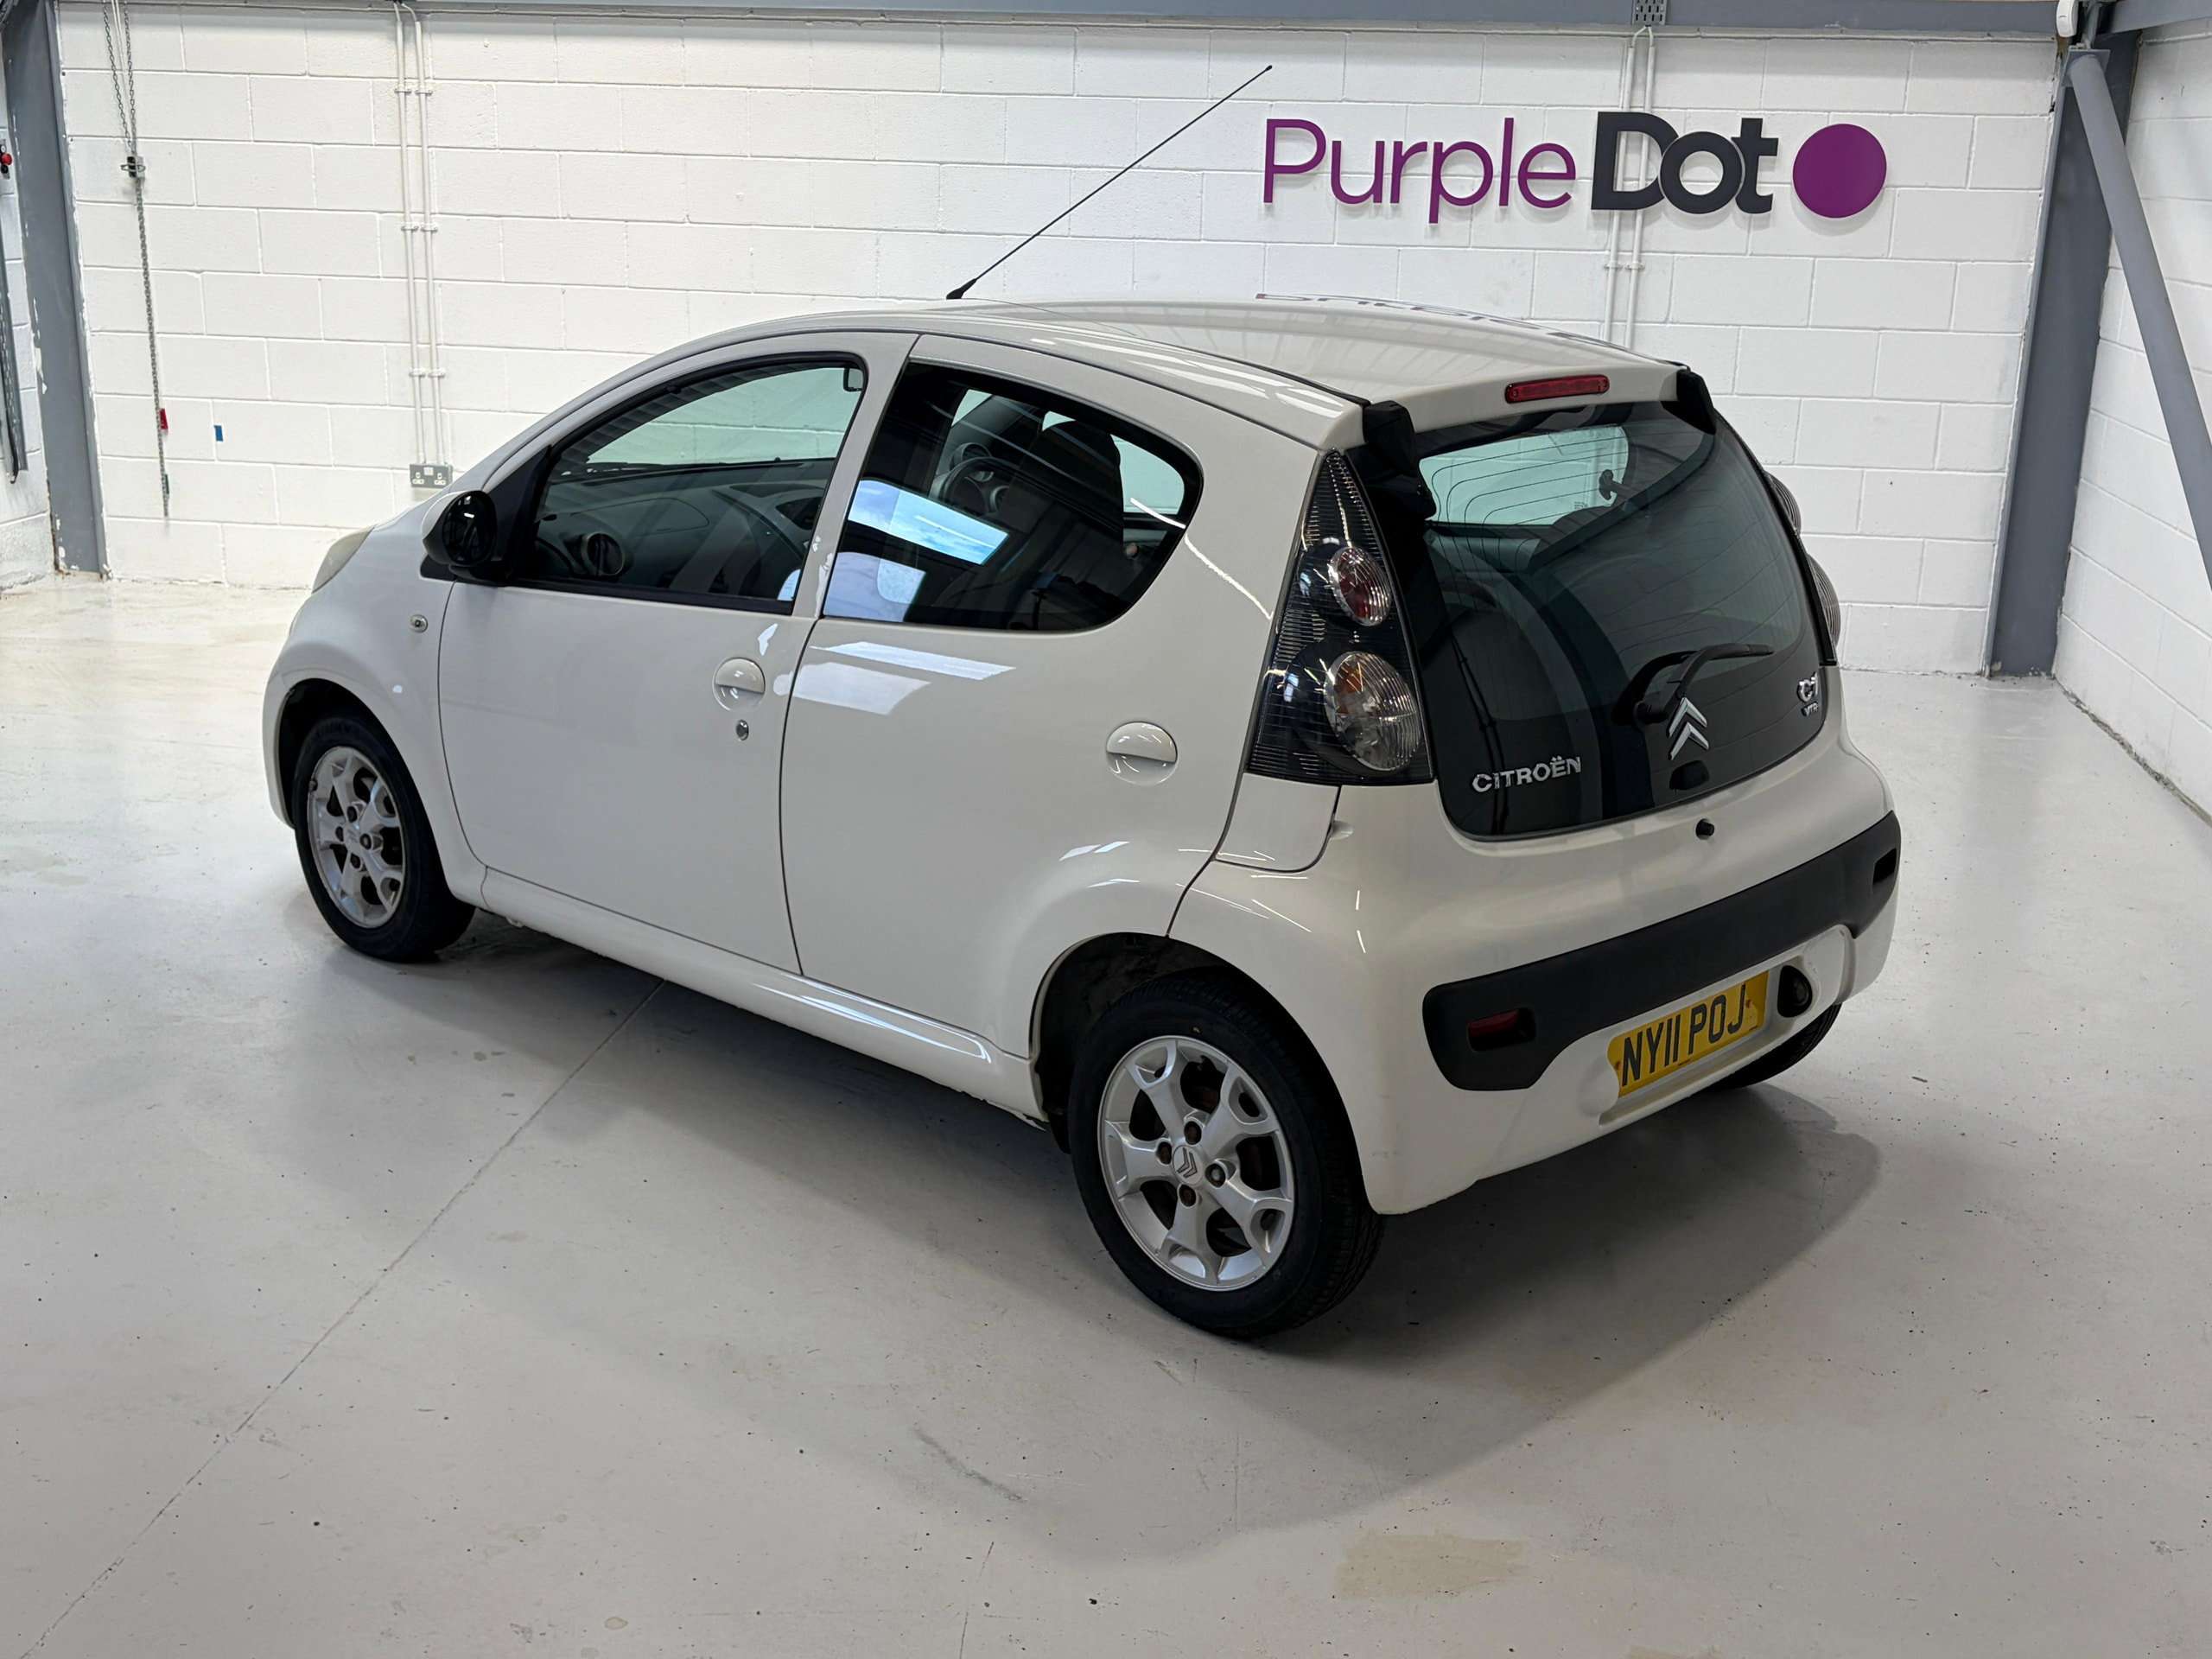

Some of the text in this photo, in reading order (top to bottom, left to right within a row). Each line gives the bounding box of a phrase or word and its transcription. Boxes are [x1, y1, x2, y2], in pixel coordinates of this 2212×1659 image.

[1263, 111, 1779, 224] Purple Dot
[1471, 755, 1581, 793] CITROËN
[1622, 984, 1746, 1086] NY11 POJ
